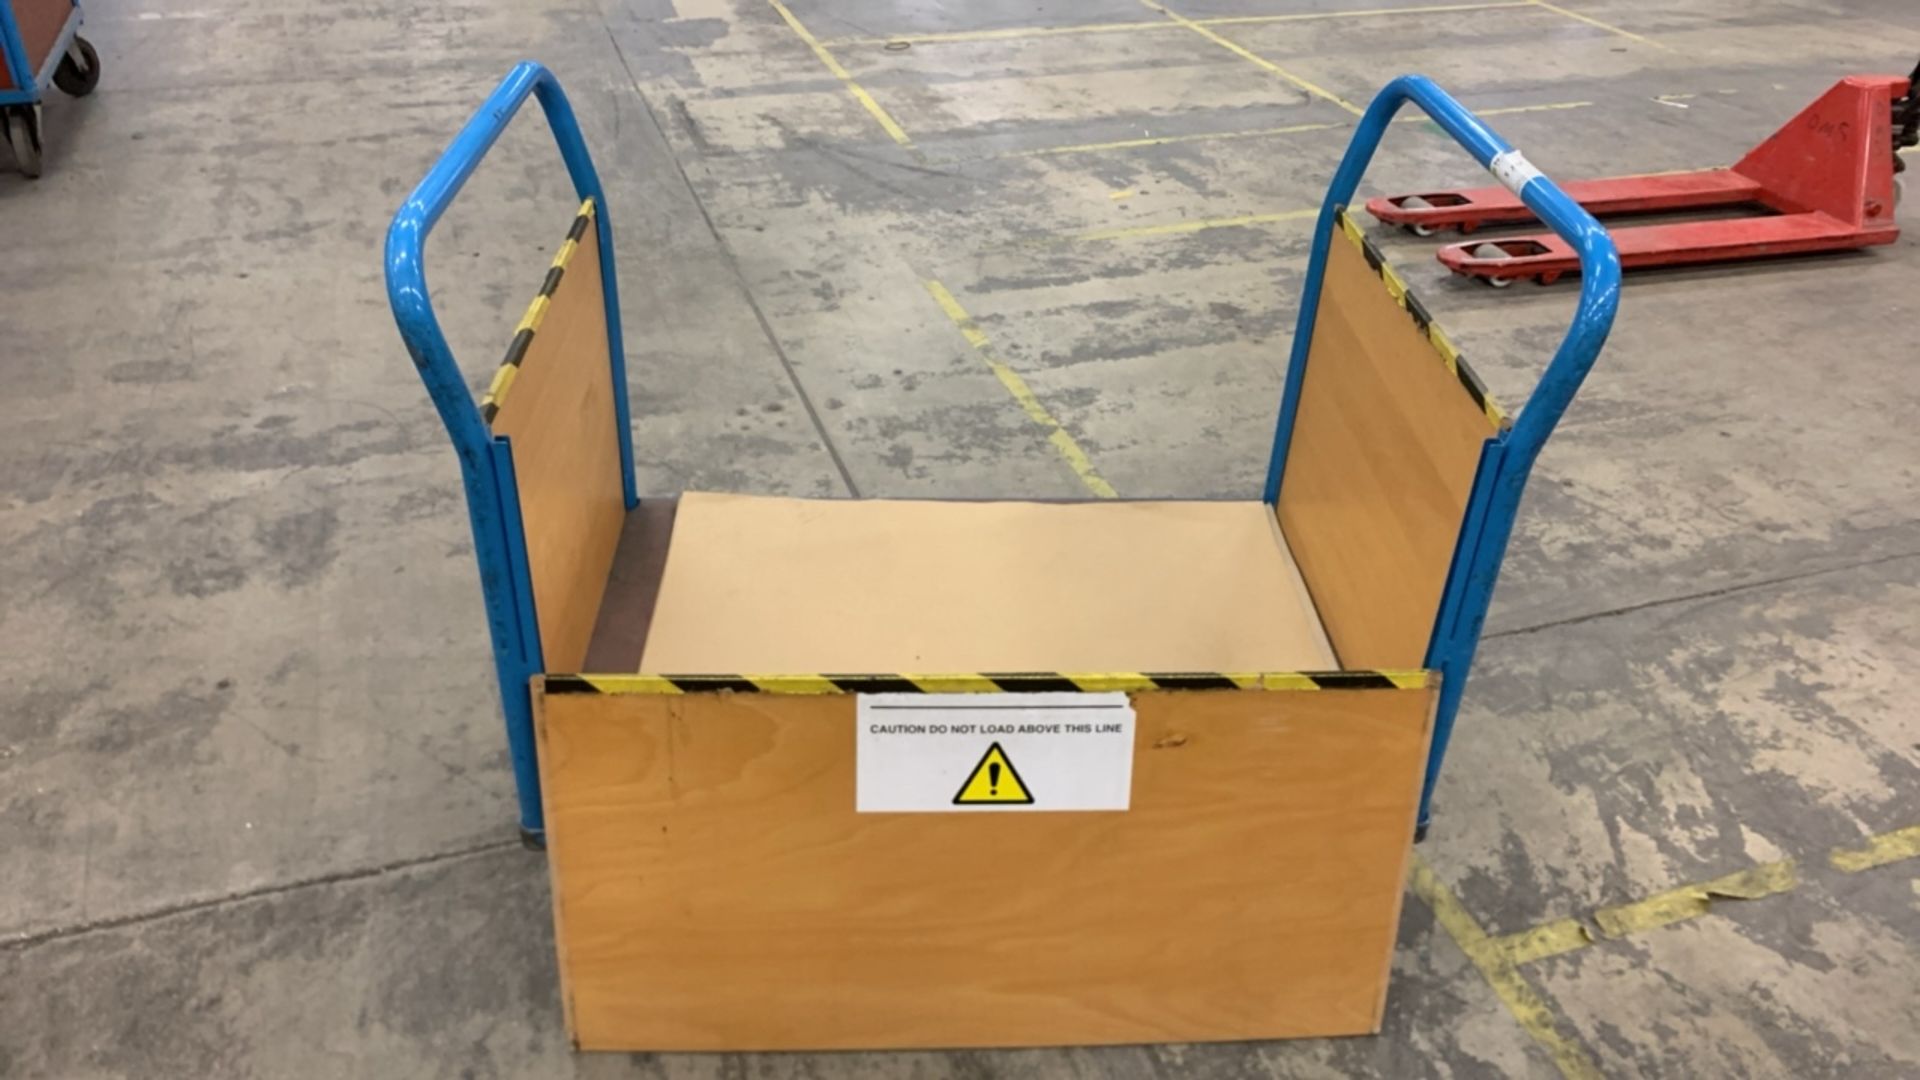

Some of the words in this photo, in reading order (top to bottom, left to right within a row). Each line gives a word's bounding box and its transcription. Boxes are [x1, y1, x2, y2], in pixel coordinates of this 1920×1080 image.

[869, 724, 925, 734] CAUTION
[929, 724, 948, 734] DO
[950, 724, 976, 734] NOT
[980, 724, 1015, 734] LOAD
[1018, 724, 1060, 733] ABOVE
[1065, 724, 1092, 733] THIS
[1095, 724, 1122, 733] LINE
